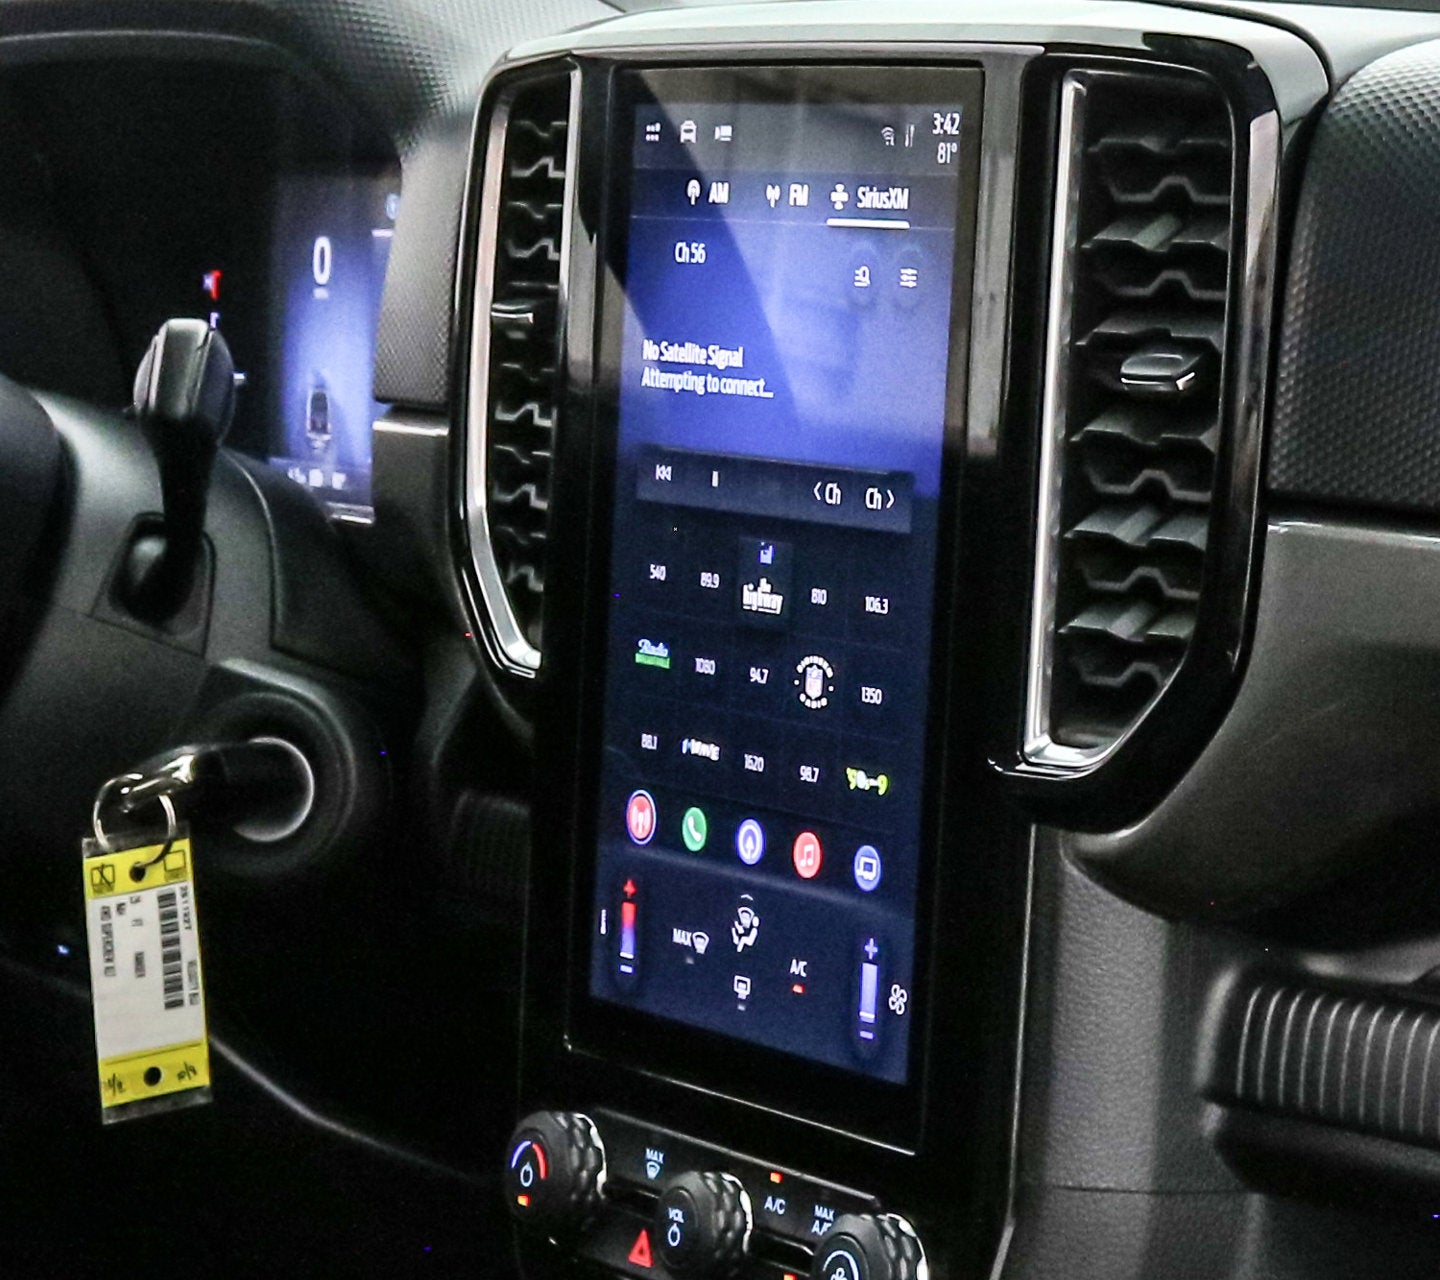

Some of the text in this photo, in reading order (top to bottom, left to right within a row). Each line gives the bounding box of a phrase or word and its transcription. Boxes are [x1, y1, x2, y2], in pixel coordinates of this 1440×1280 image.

[932, 113, 960, 136] 3:42
[709, 182, 730, 204] AM
[789, 182, 810, 206] FM
[857, 186, 910, 210] SiriusXM
[313, 236, 331, 285] 0
[675, 242, 706, 263] Ch 56
[643, 340, 743, 370] No Satellite Signal
[641, 367, 706, 395] Attempting
[707, 373, 720, 393] to
[825, 482, 841, 505] Ch
[865, 487, 882, 510] Ch
[673, 928, 692, 946] MAX
[790, 959, 808, 977] A/C
[646, 1148, 664, 1164] MAX
[668, 1207, 685, 1223] VOL
[764, 1196, 786, 1215] A/C
[814, 1205, 835, 1222] MAX
